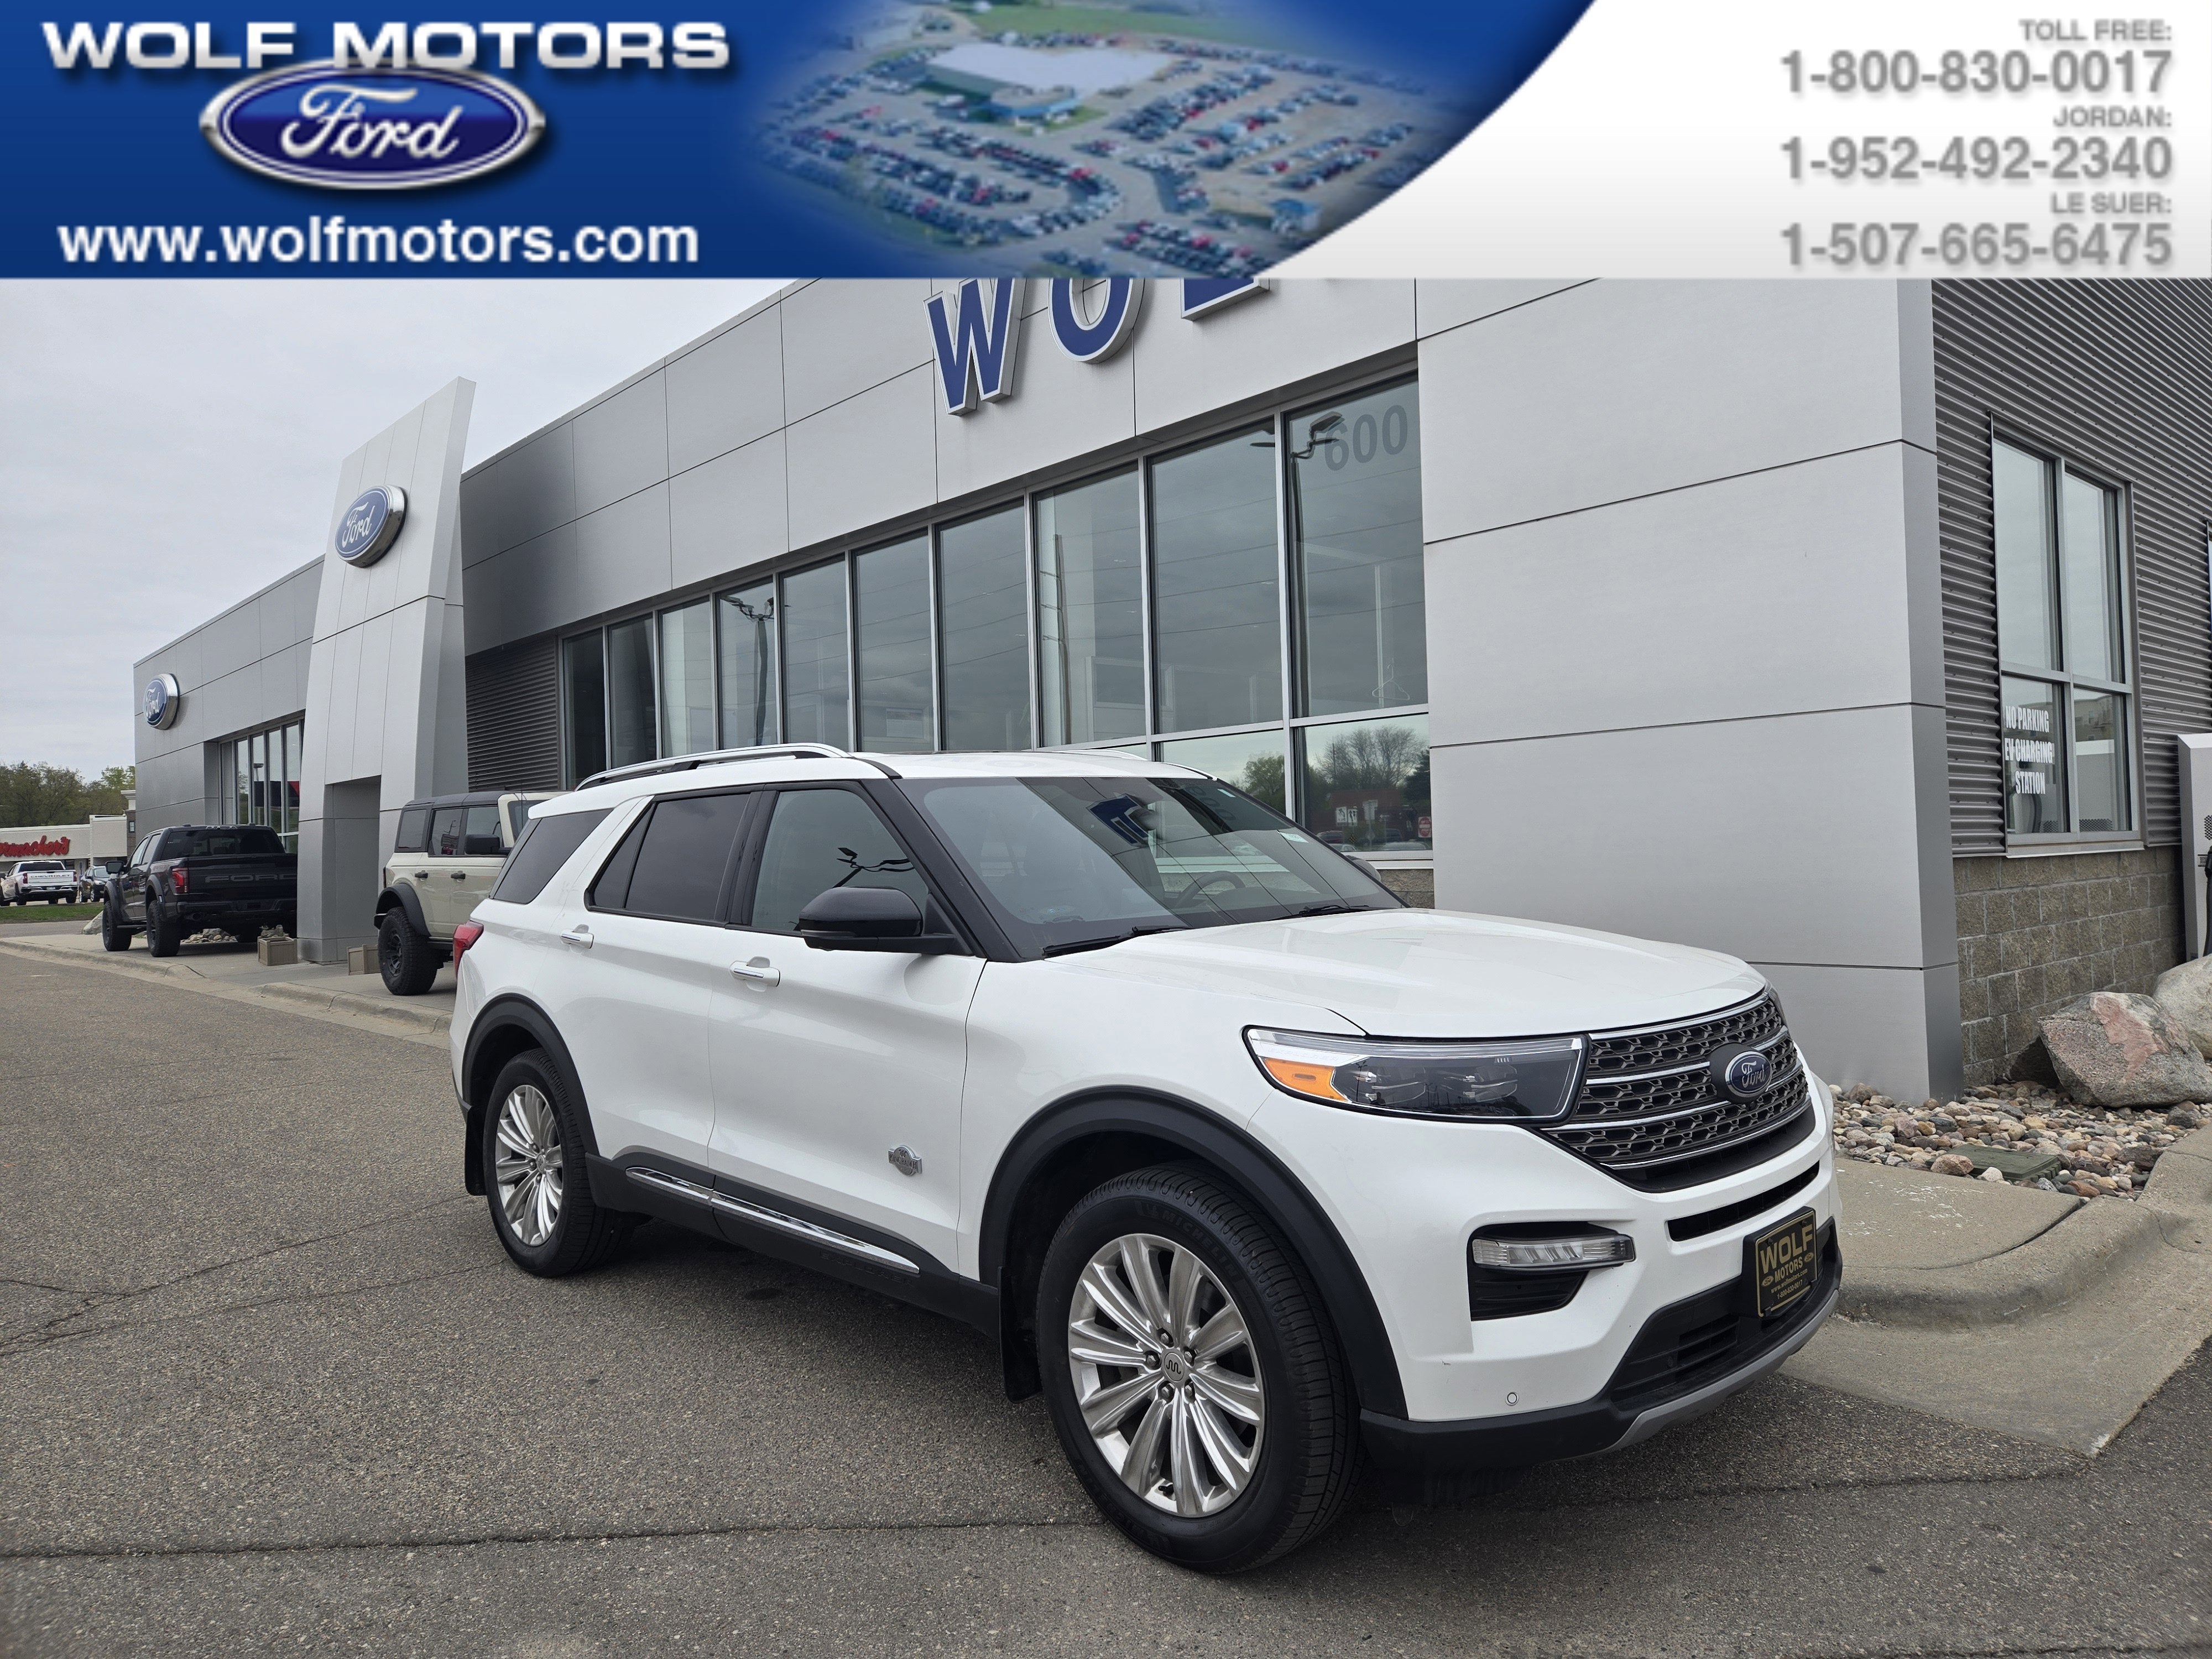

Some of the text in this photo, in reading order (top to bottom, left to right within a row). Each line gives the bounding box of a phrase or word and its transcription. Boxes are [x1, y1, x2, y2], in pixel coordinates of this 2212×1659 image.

[1324, 405, 1408, 471] 600
[342, 502, 375, 548] Ford
[145, 687, 160, 719] Ford
[2005, 706, 2049, 733] NO PARKING
[2004, 738, 2053, 763] EV CHARGING
[2015, 770, 2046, 794] STATION
[1741, 1061, 1766, 1088] Ford
[1760, 1224, 1813, 1274] WOLF
[1775, 1256, 1803, 1283] MOTORS
